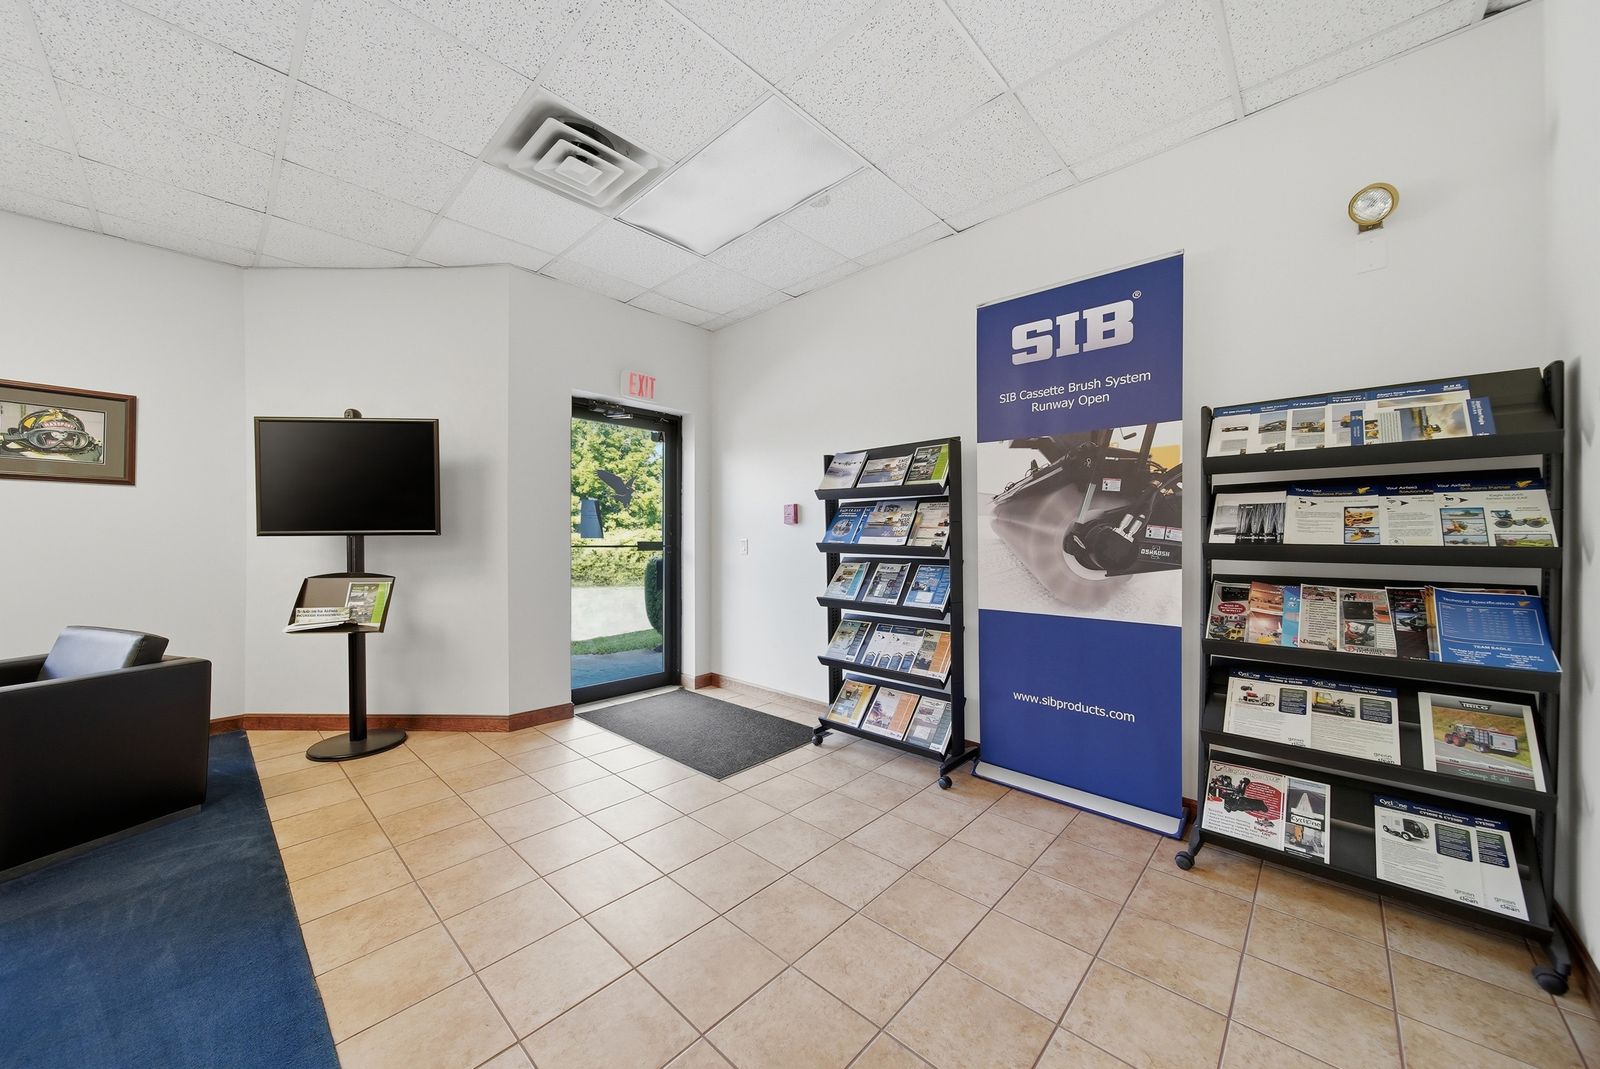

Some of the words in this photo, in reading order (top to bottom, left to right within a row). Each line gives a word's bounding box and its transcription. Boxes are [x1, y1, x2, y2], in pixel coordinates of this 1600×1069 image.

[1012, 299, 1134, 366] SIB
[629, 371, 656, 399] EXIT
[999, 392, 1017, 404] SIB
[1019, 385, 1065, 401] Cassette
[1068, 378, 1101, 393] Brush
[1105, 371, 1151, 388] System
[1031, 397, 1075, 413] Runway
[1078, 392, 1110, 407] Open
[1140, 547, 1170, 559] OSHKOSH
[1443, 596, 1469, 604] Technical
[1471, 599, 1516, 607] Specifications
[1013, 691, 1135, 723] www.sibproducts.com
[1459, 896, 1479, 905] clean
[1500, 904, 1521, 913] clean
